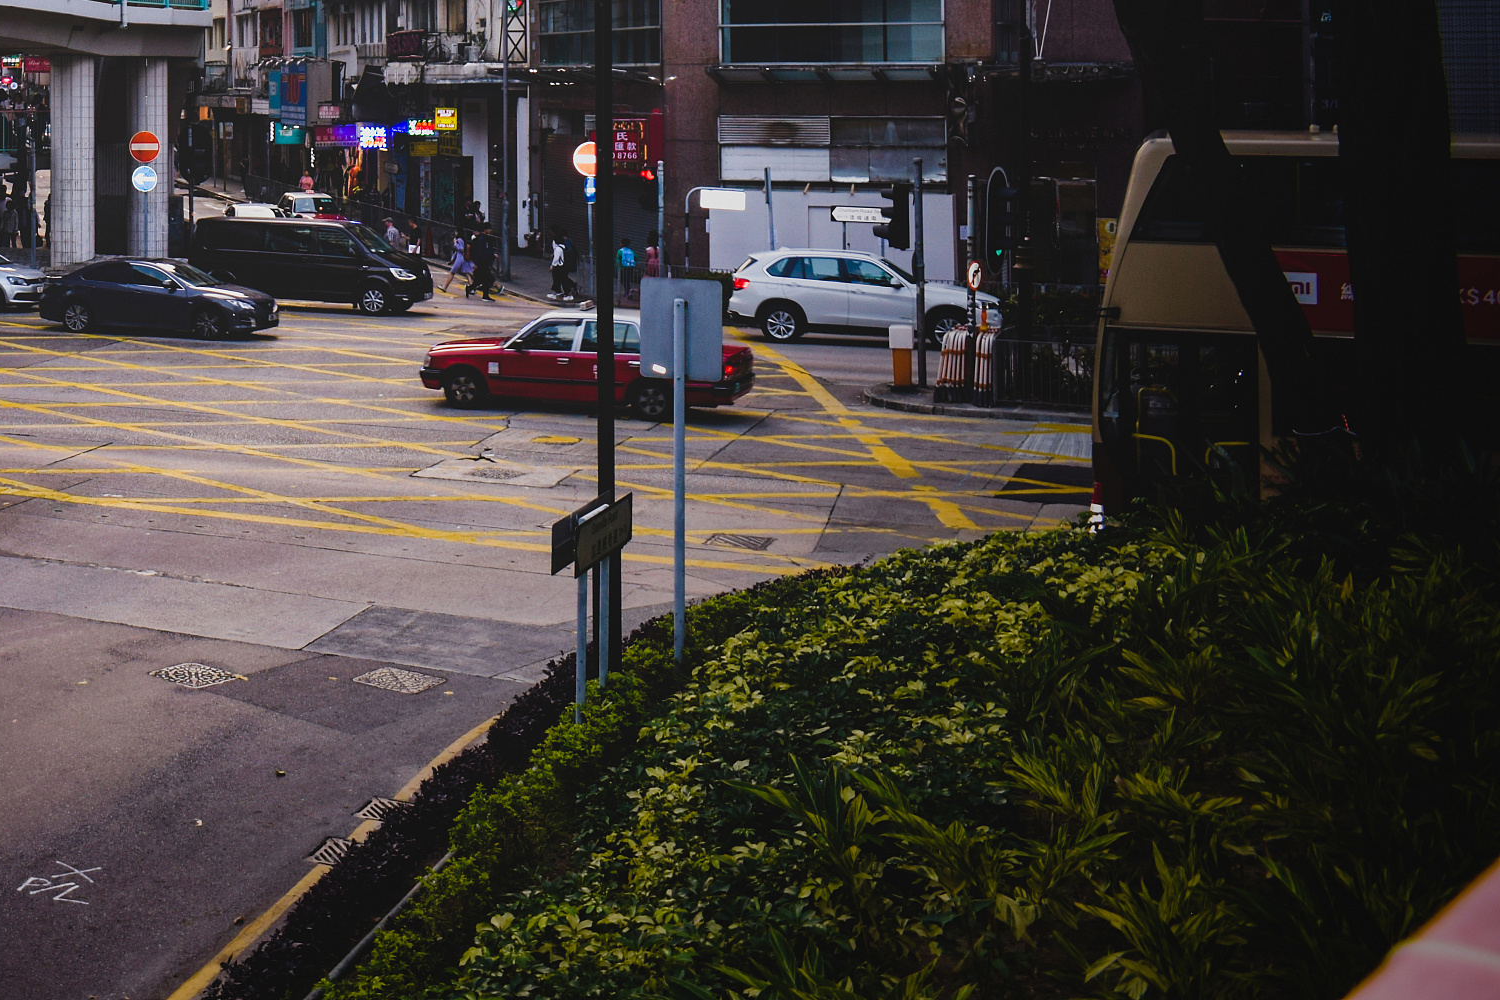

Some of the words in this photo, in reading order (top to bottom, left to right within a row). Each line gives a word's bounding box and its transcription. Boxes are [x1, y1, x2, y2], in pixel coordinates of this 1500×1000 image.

[616, 131, 628, 141] 氏
[614, 141, 637, 151] 匯款
[617, 152, 638, 160] 8766
